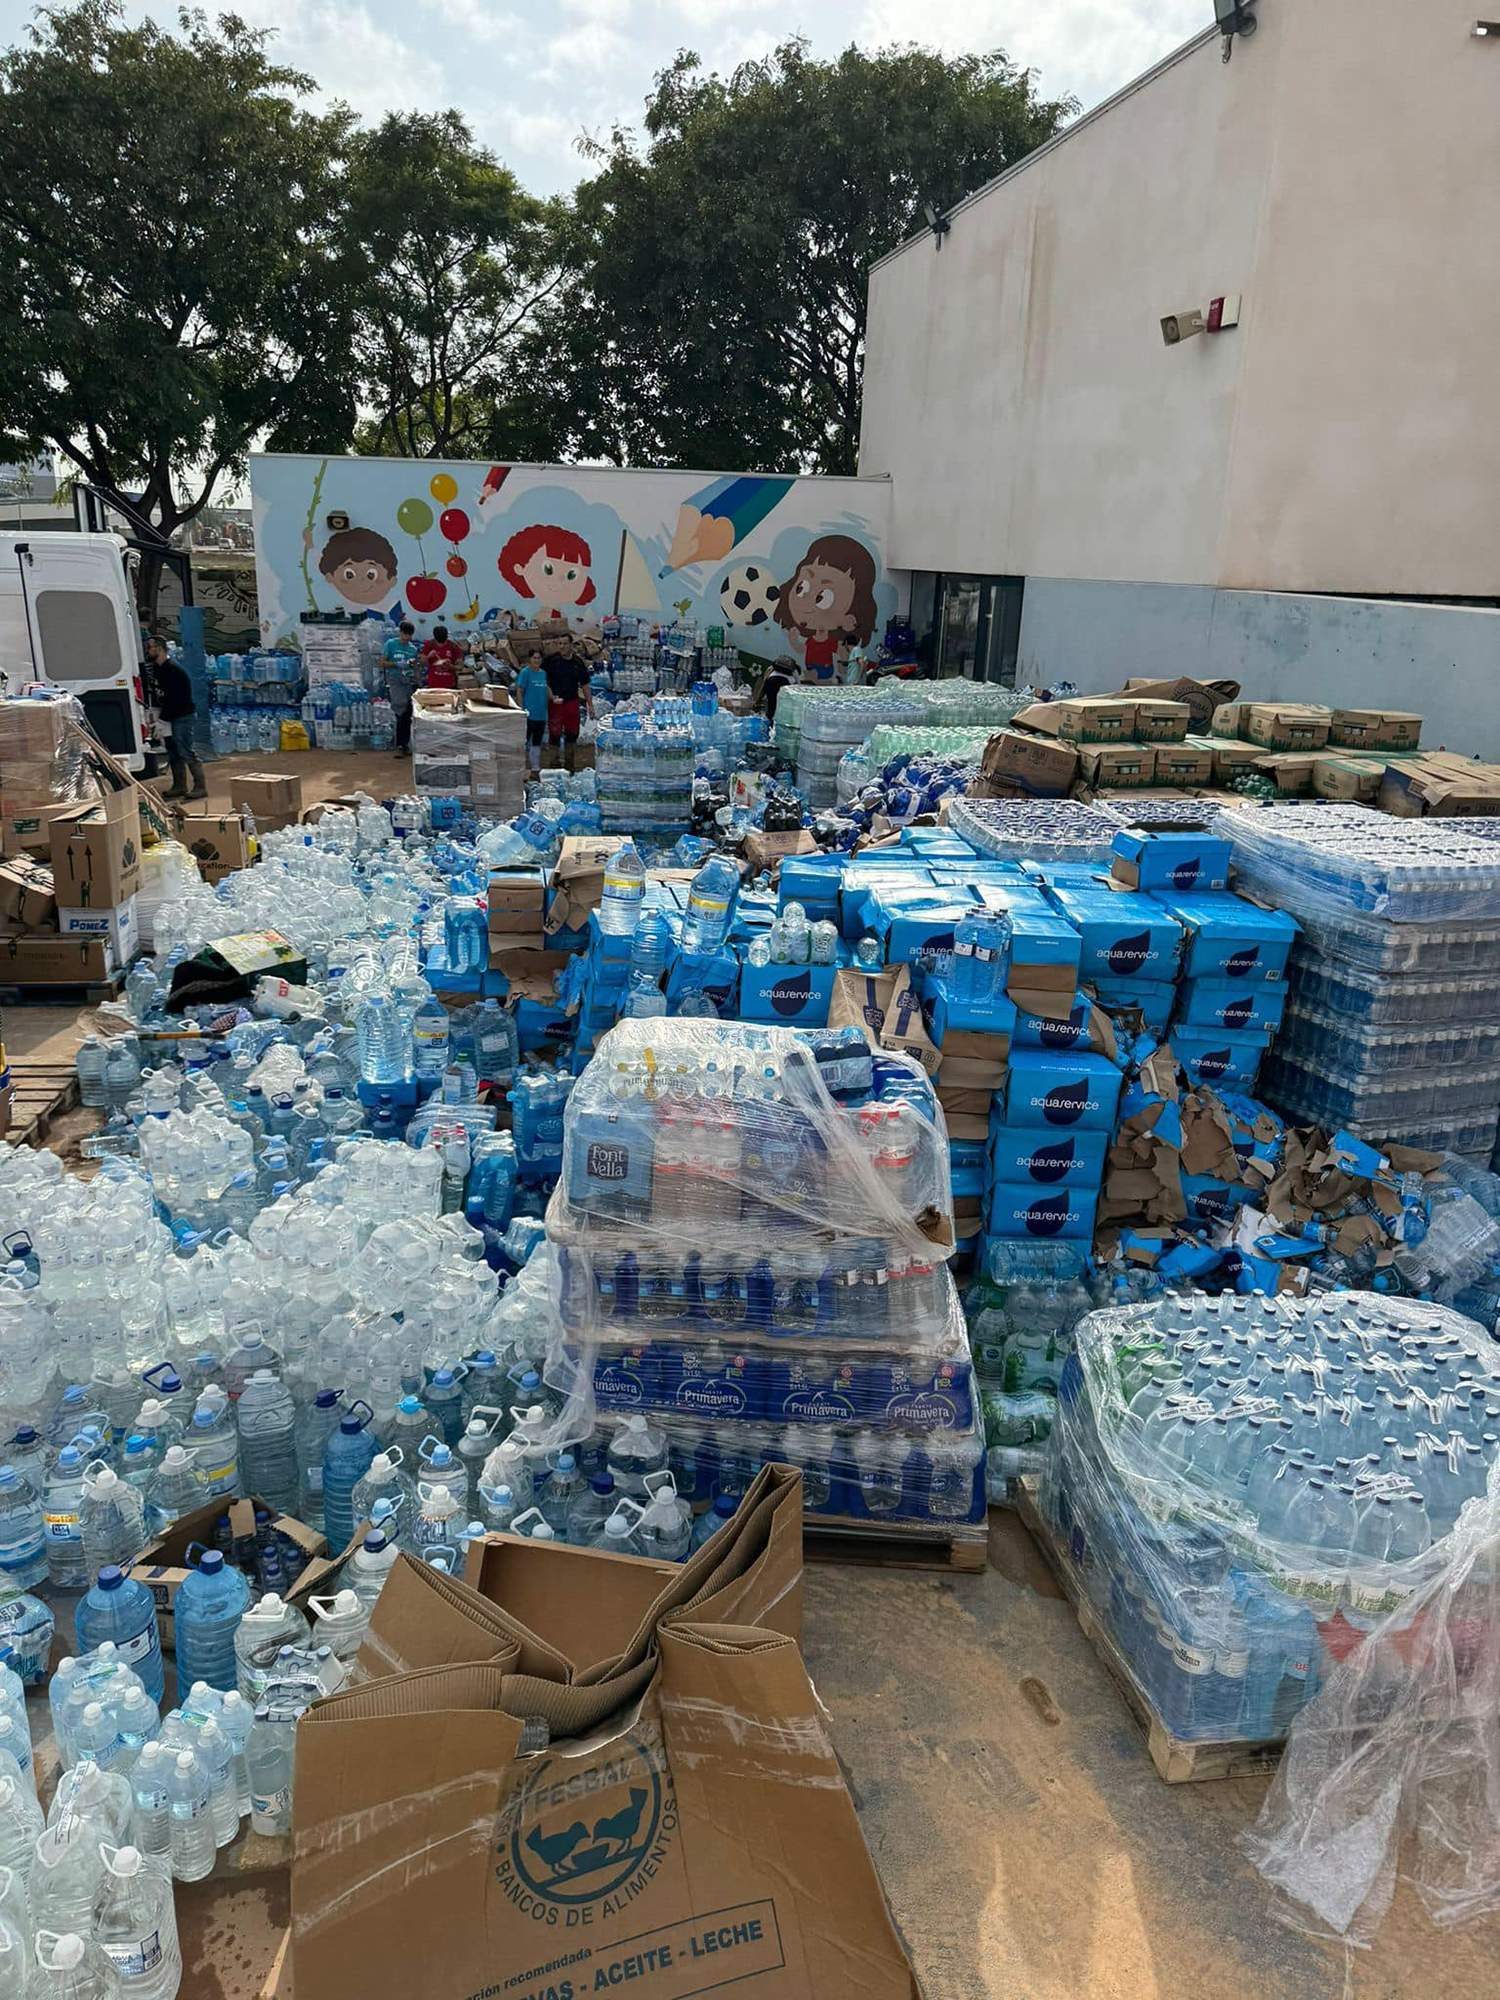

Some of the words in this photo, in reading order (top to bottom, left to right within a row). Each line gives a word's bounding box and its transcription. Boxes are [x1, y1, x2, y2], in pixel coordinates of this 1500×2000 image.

[1096, 949, 1159, 960] aquaservice
[759, 989, 822, 1000] aquaservice
[1215, 1009, 1260, 1019] aquaservice
[1190, 1058, 1237, 1071] aquaservice
[1030, 1097, 1099, 1110] aquaservice
[591, 1145, 625, 1162] Font
[591, 1160, 624, 1177] Vella
[1016, 1157, 1085, 1168] aquaservice
[1013, 1210, 1081, 1222] aquaservice
[593, 1379, 638, 1394] rimavera
[684, 1389, 740, 1405] Primavera
[791, 1402, 848, 1417] Primavera
[894, 1406, 950, 1418] Primavera
[495, 1859, 559, 1925] BANCOS
[566, 1906, 593, 1927] DE
[602, 1798, 678, 1918] ALIMENTOS
[594, 1945, 673, 1991] ACEITE
[691, 1919, 764, 1957] LECHE
[503, 1947, 592, 1990] recomendada
